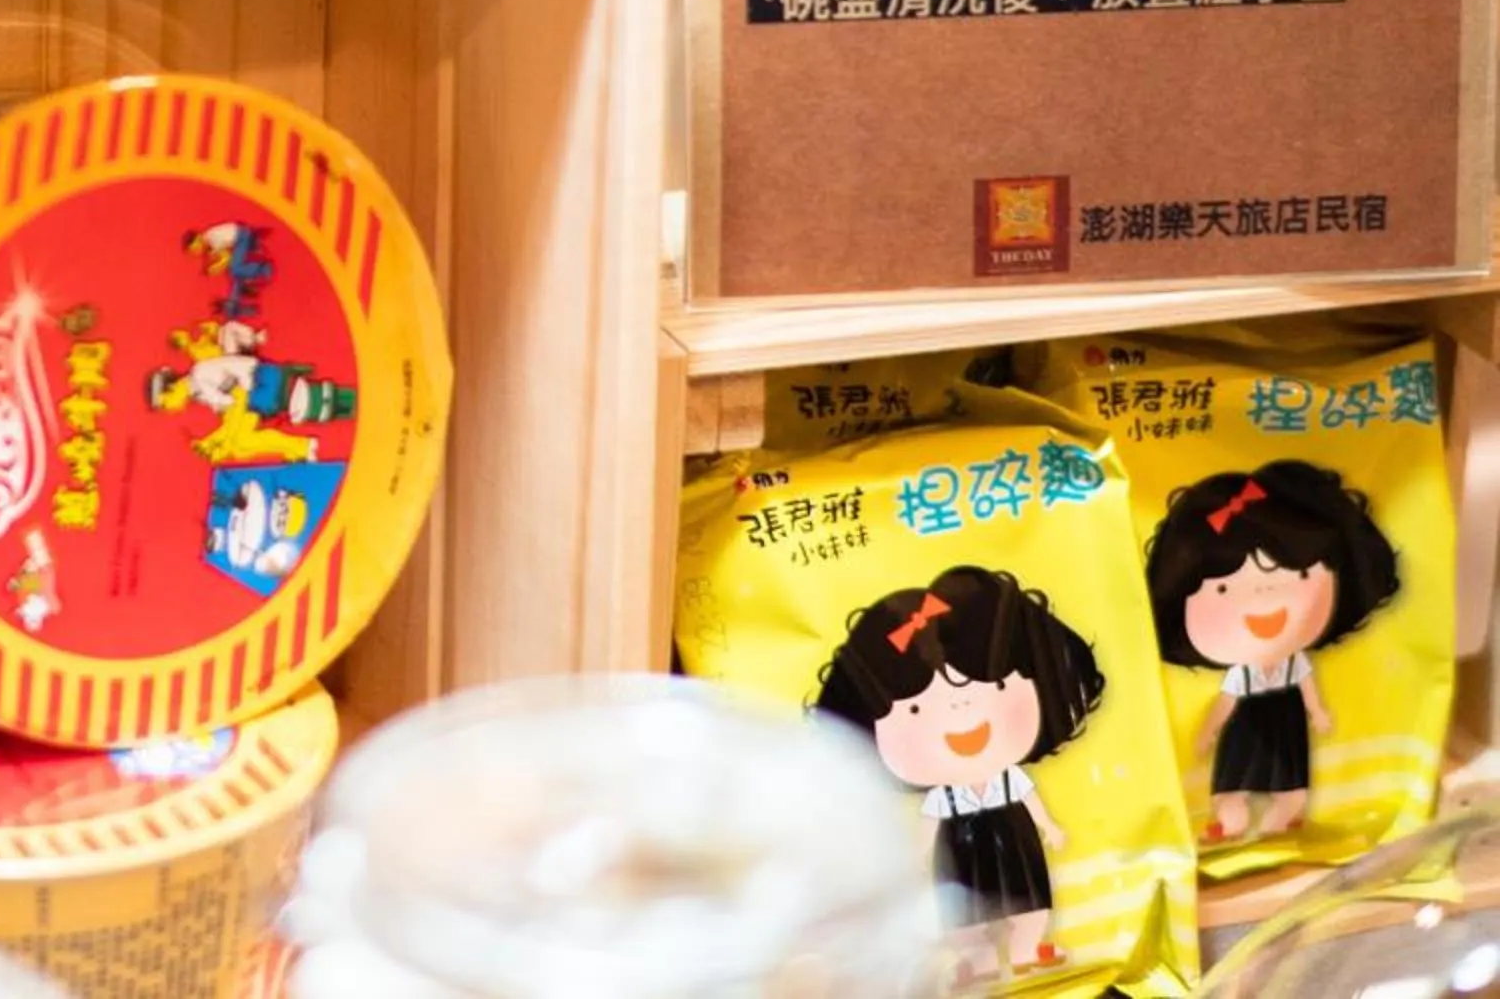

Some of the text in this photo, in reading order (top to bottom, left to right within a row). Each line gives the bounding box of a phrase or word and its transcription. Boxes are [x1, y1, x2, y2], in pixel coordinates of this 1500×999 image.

[1079, 194, 1388, 244] 澎湖樂天旅店民宿
[1090, 377, 1216, 420] 張君雅
[896, 441, 1107, 535] 捏碎麵
[737, 487, 864, 548] 張君雅
[790, 525, 871, 567] 小妹妹
